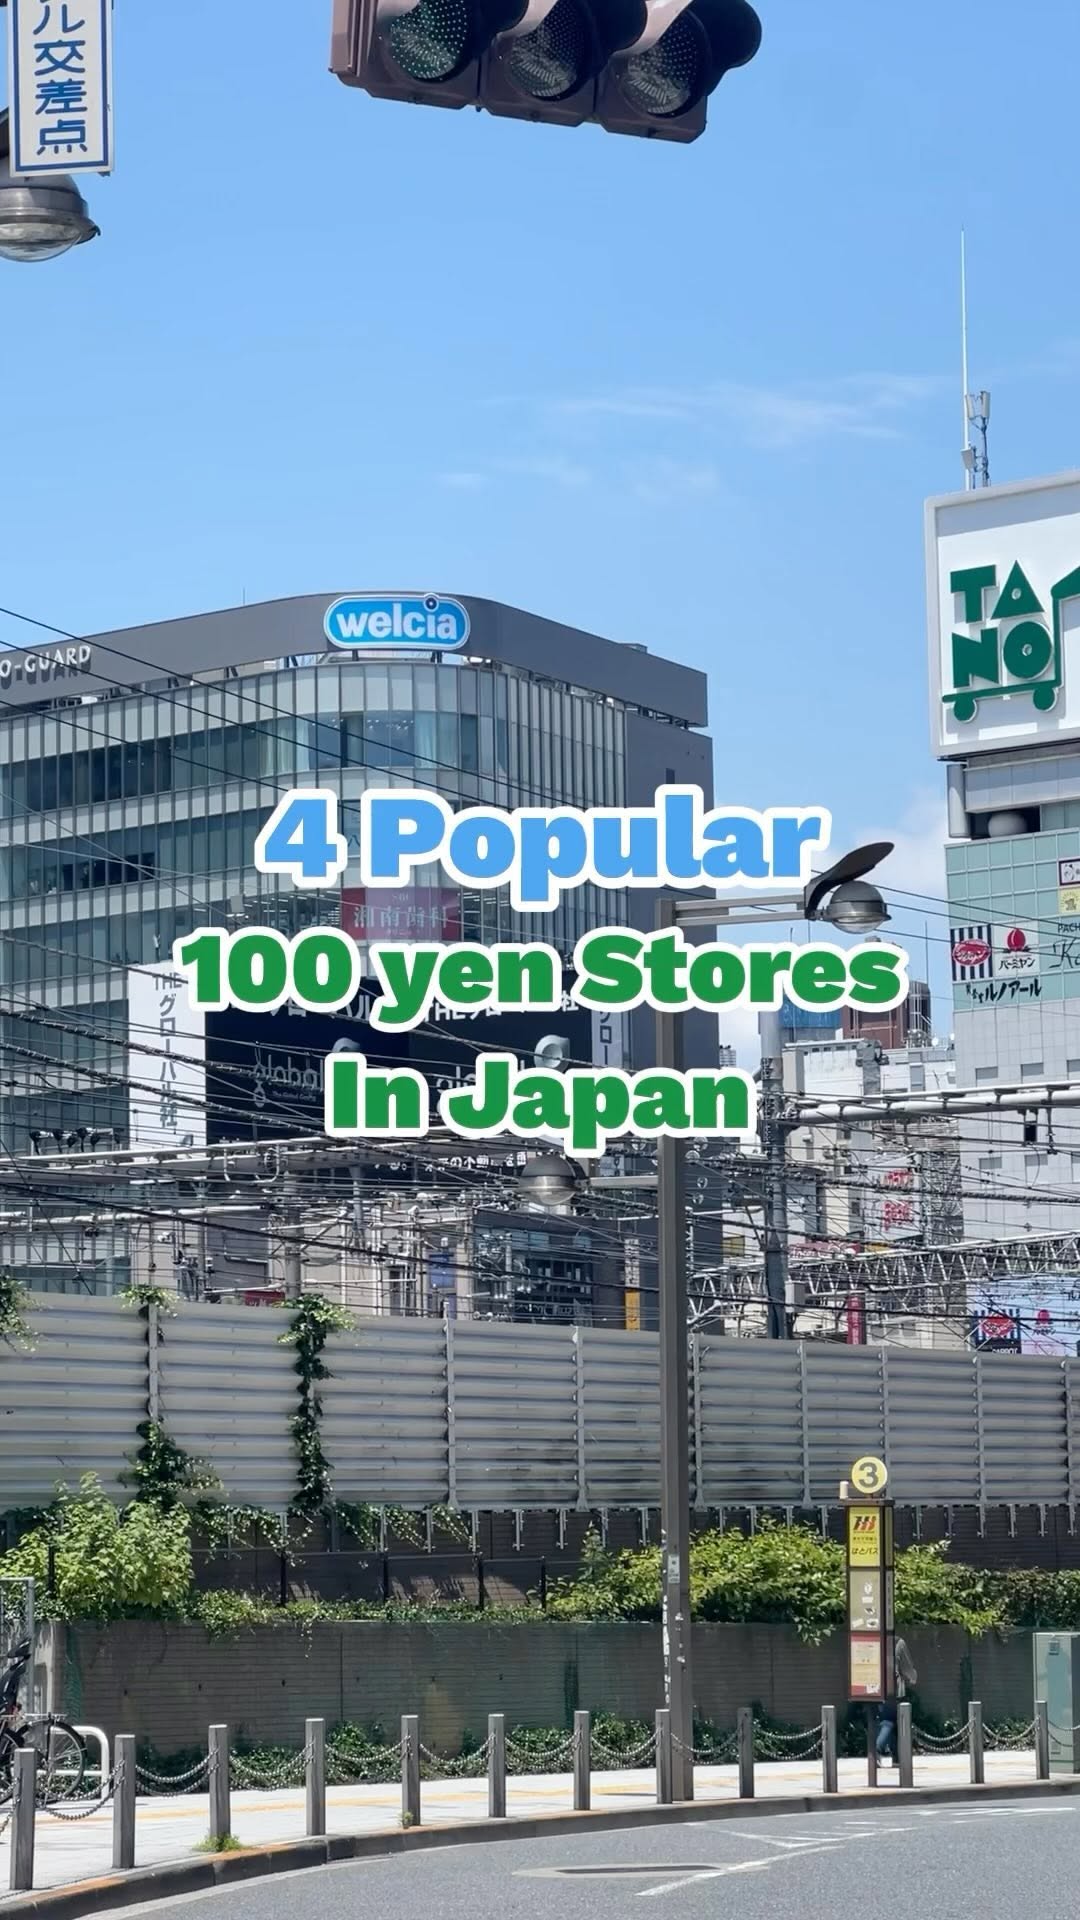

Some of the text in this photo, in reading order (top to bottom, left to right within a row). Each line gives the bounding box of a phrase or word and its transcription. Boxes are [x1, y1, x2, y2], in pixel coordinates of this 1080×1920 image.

[33, 0, 88, 156] ル交差点
[336, 598, 457, 640] welcia
[0, 645, 91, 678] O-GUARD
[998, 957, 1036, 970] バーミヤン
[859, 1462, 879, 1488] 3
